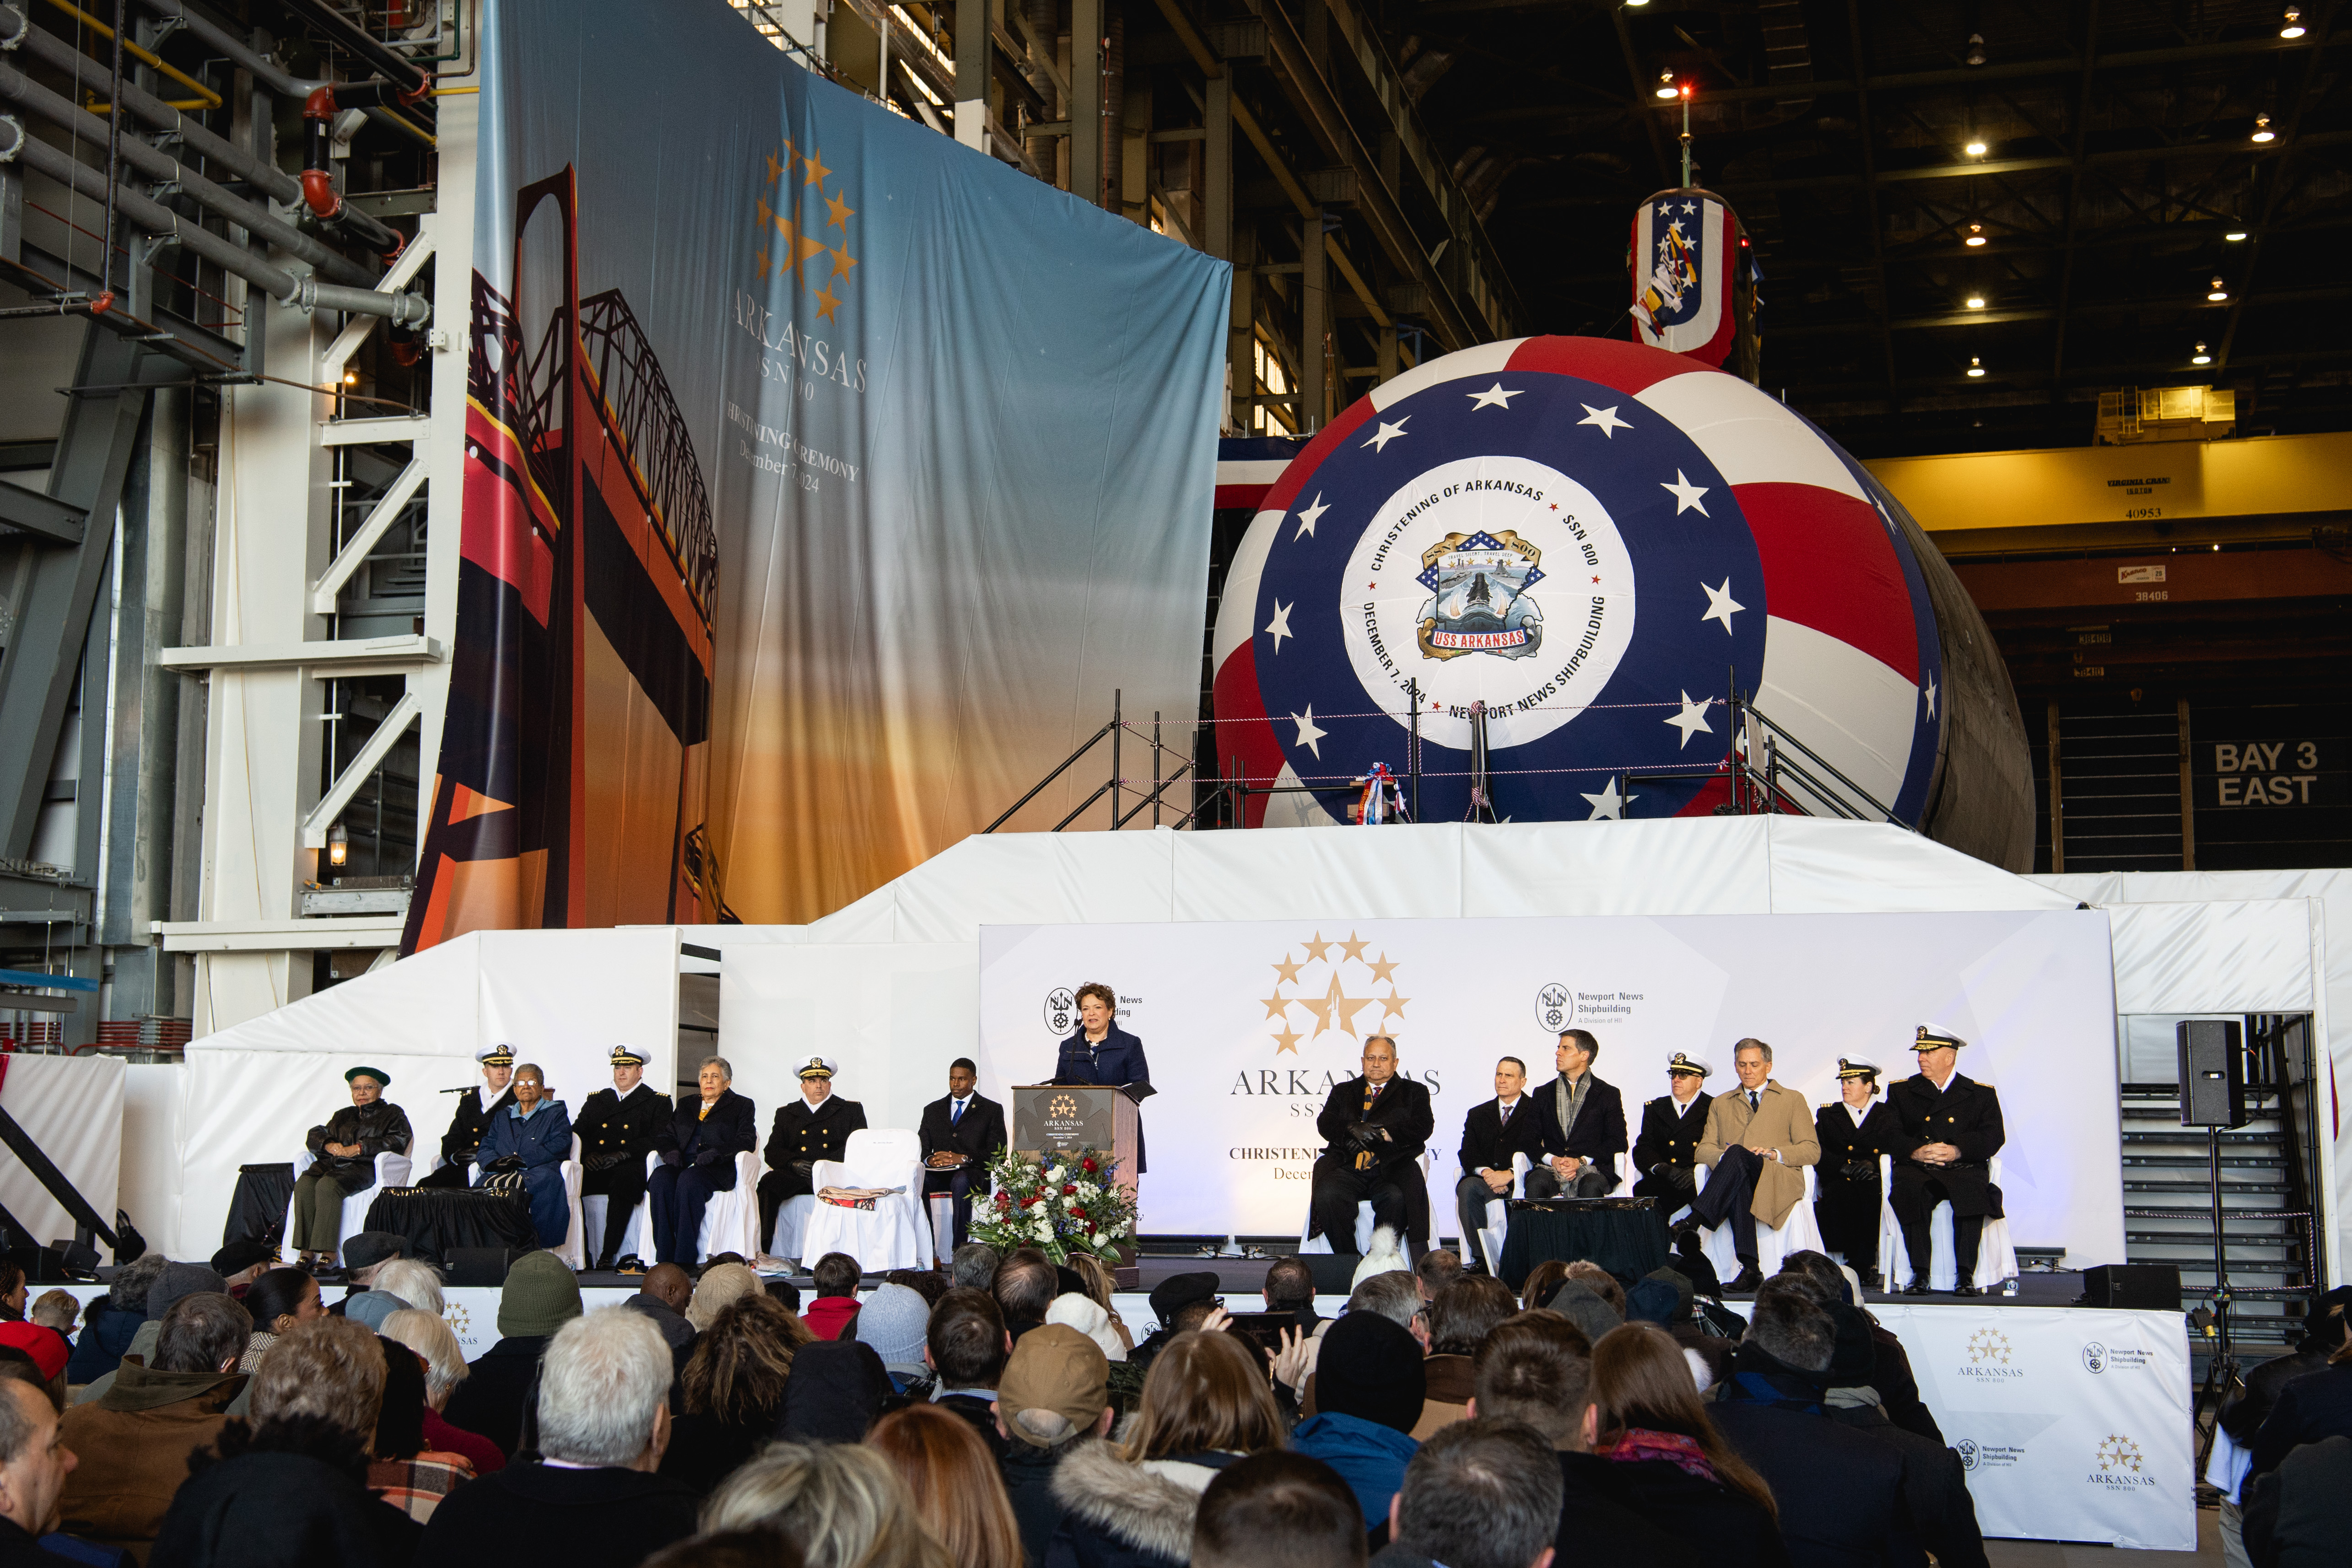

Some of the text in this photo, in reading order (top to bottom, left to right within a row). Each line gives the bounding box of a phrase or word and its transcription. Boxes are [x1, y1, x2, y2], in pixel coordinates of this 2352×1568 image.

[733, 288, 866, 393] ARKANSAS
[756, 352, 790, 383] SSN
[794, 438, 859, 482] CREMONY
[2126, 508, 2161, 518] 40953
[1371, 480, 1543, 571] CHRISTENING OF ARKANSAS
[1562, 514, 1599, 566] SSN 800
[1426, 541, 1536, 561] SSN 800
[2136, 591, 2169, 601] 38406
[1363, 602, 1393, 671] DECEMBER
[1435, 630, 1524, 647] USS ARKANSAS
[1517, 682, 1557, 712] NEWS
[1555, 596, 1605, 686] SHIPBUILDING
[2215, 741, 2318, 772] BAY 3
[2218, 776, 2317, 805] EAST
[1120, 996, 1143, 1004] News
[1578, 992, 1644, 1002] Newport News
[1578, 1004, 1631, 1015] Shipbuilding
[2110, 1356, 2146, 1364] Shipbuilding
[1958, 1367, 2023, 1377] ARKANSAS
[2087, 1474, 2155, 1486] ARKANSAS
